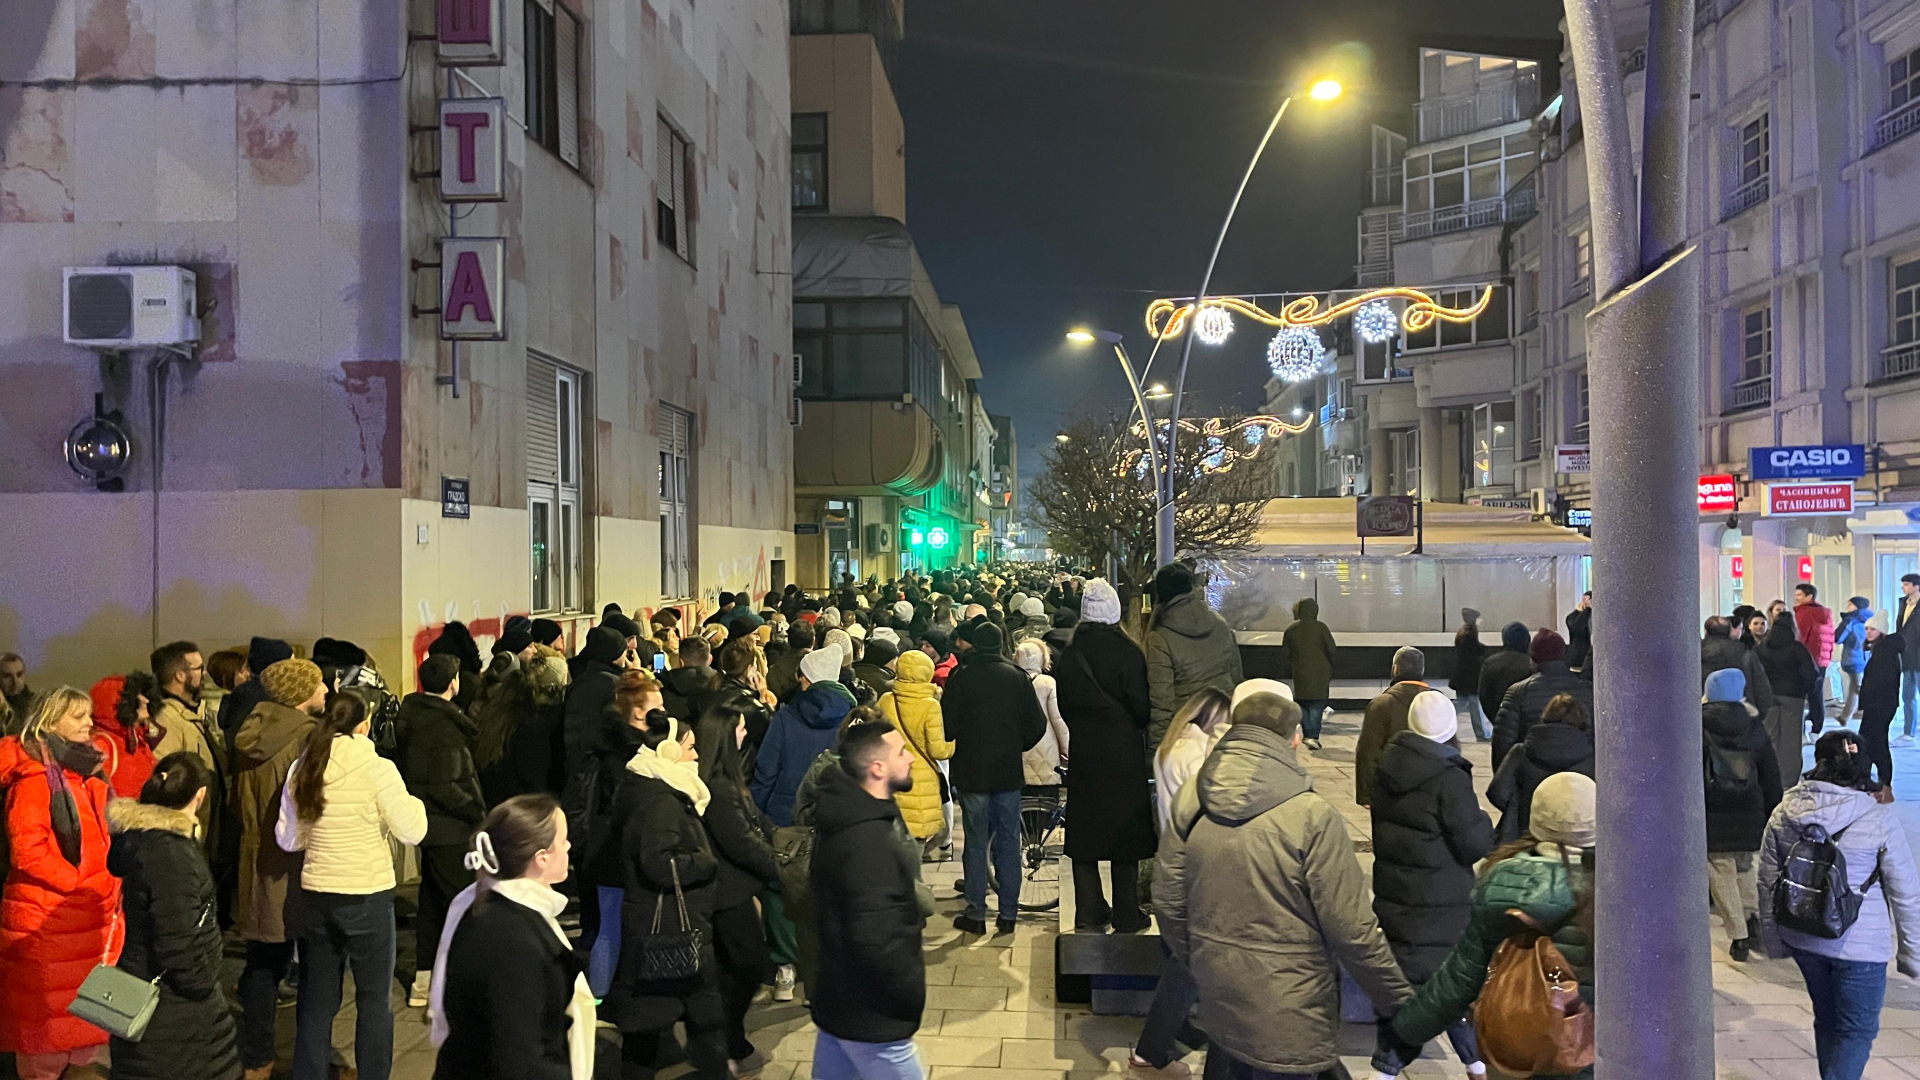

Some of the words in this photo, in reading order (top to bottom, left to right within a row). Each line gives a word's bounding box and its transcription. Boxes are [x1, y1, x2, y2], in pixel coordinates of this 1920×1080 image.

[1770, 448, 1851, 467] CASIO
[1779, 487, 1842, 497] ЧАСОВНИЧАР
[1775, 498, 1846, 511] СТАНОЈЕВИЋ
[1568, 516, 1592, 527] Shop
